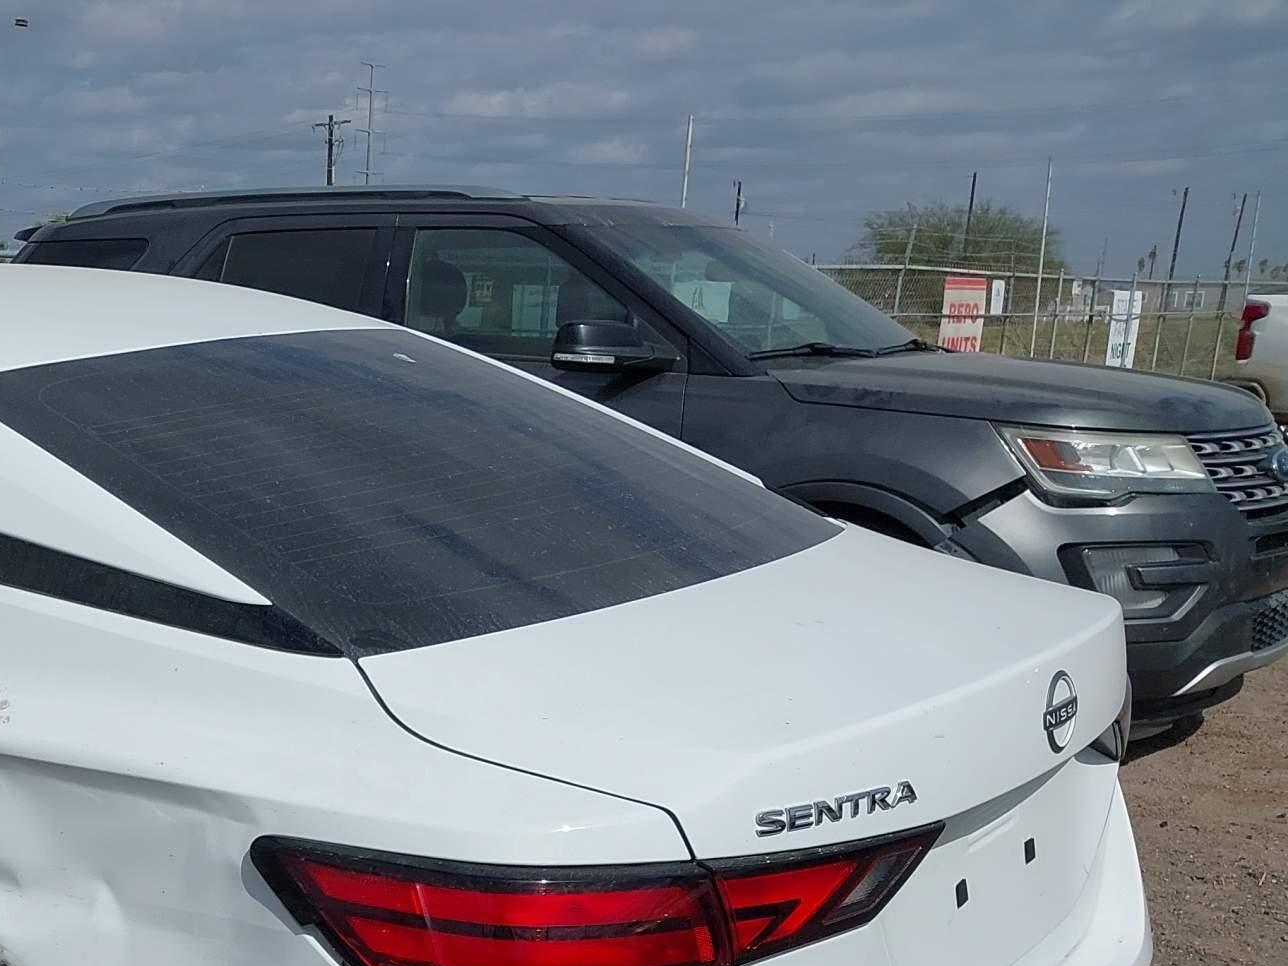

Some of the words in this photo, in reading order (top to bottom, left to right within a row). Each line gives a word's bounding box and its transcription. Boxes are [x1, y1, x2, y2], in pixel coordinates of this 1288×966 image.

[947, 302, 980, 325] REPO
[1046, 701, 1077, 728] NISSA
[754, 780, 919, 838] SENTRA
